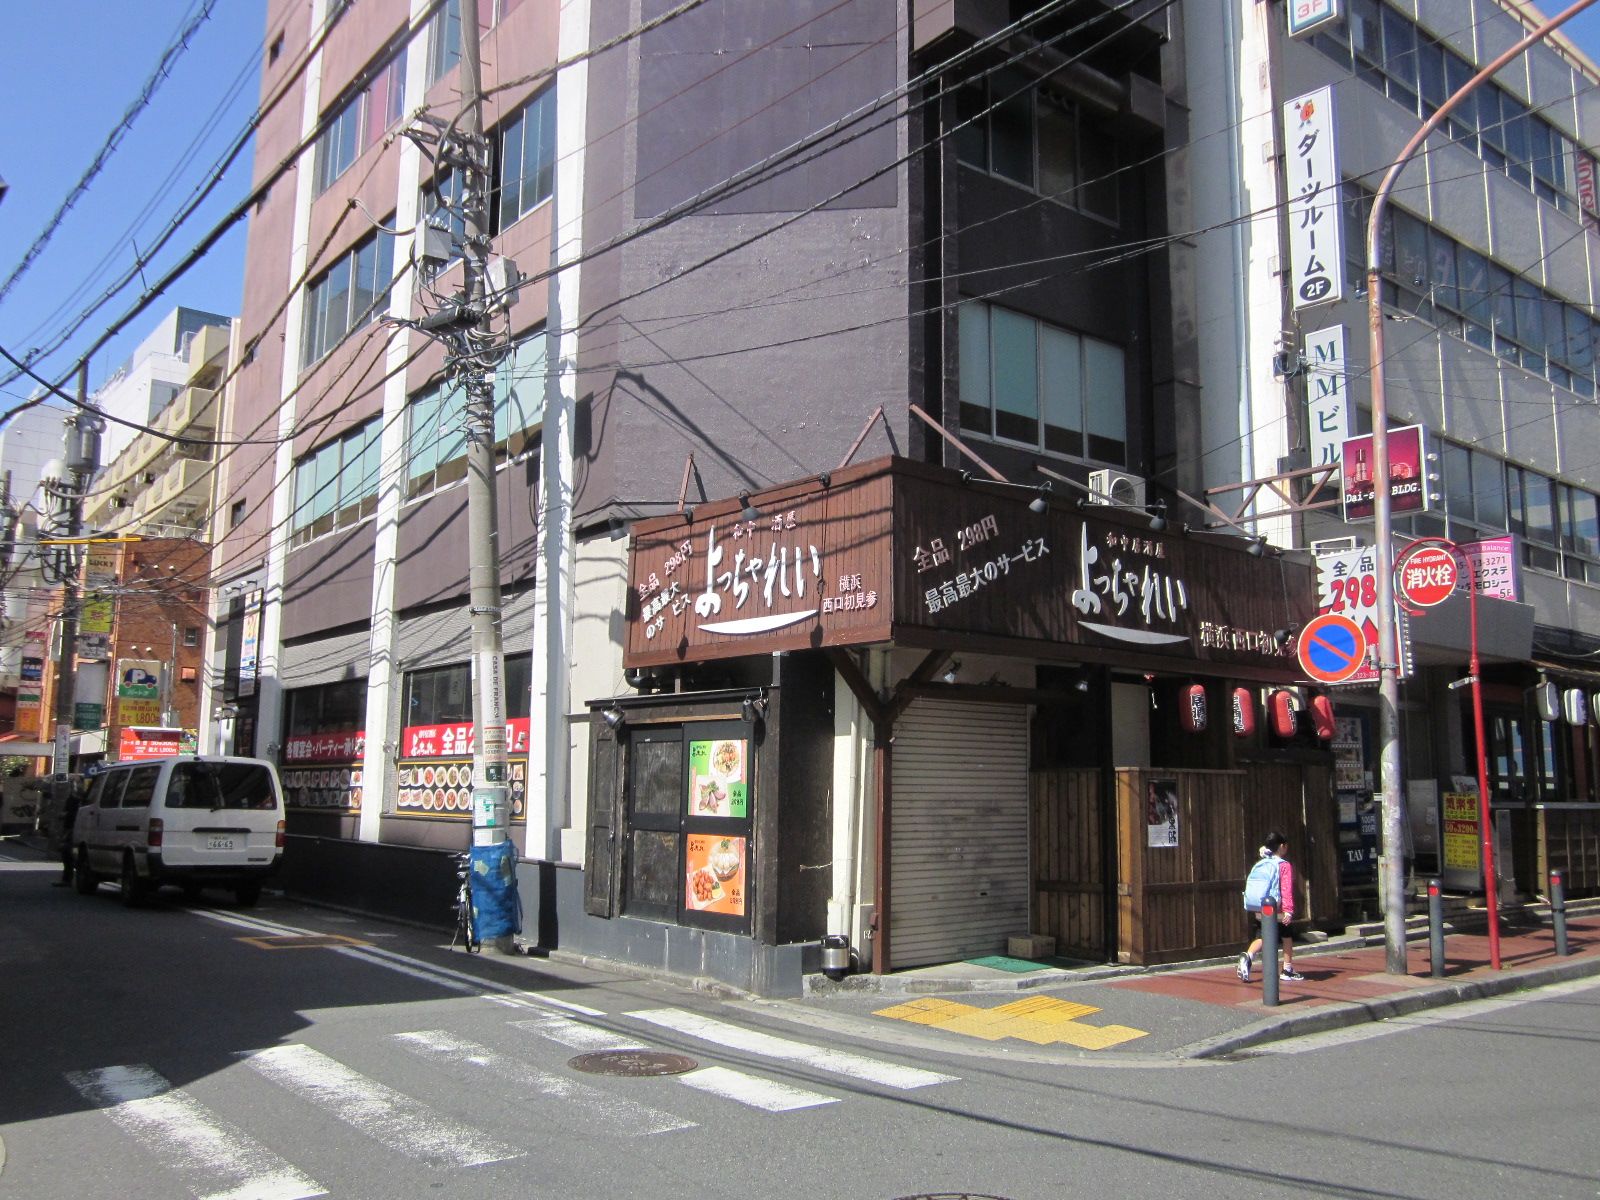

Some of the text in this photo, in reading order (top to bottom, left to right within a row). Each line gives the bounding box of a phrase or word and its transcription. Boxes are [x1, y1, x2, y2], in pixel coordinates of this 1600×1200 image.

[1298, 129, 1325, 277] ダーツルーム
[1306, 283, 1325, 298] 2F
[1391, 482, 1421, 496] BLDG.
[912, 513, 1000, 574] 全品 298円
[1481, 544, 1509, 552] Balance
[663, 539, 694, 577] 298円
[1410, 554, 1447, 565] FIRE HYDRANT
[839, 573, 862, 593] 横浜
[924, 536, 1051, 616] 最高最大のサービス
[1406, 563, 1453, 590] 消火栓
[822, 590, 878, 614] 西口初見参
